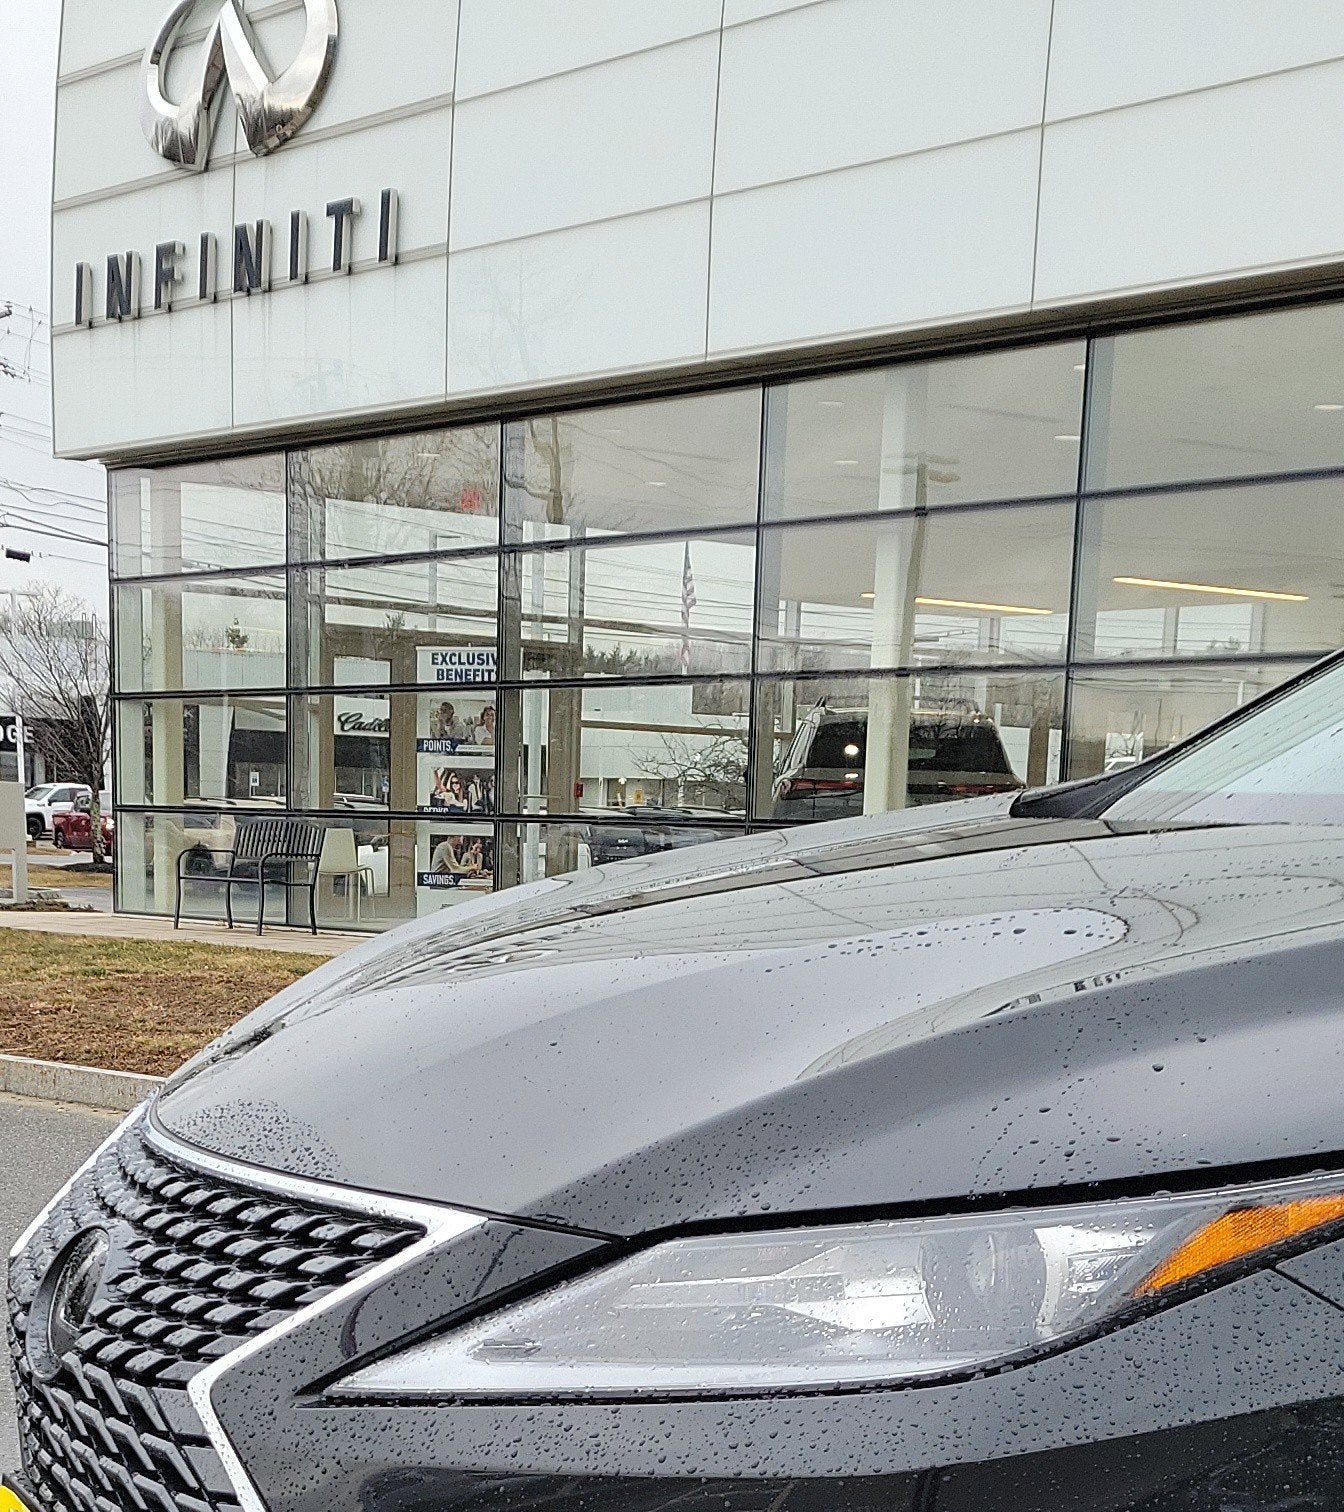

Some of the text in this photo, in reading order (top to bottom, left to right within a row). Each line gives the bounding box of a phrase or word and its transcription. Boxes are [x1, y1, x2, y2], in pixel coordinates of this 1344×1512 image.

[75, 188, 398, 326] INFINITI
[436, 668, 497, 682] BENEFIT
[423, 740, 454, 751] POINTS.
[423, 874, 456, 885] SAVINGS.
